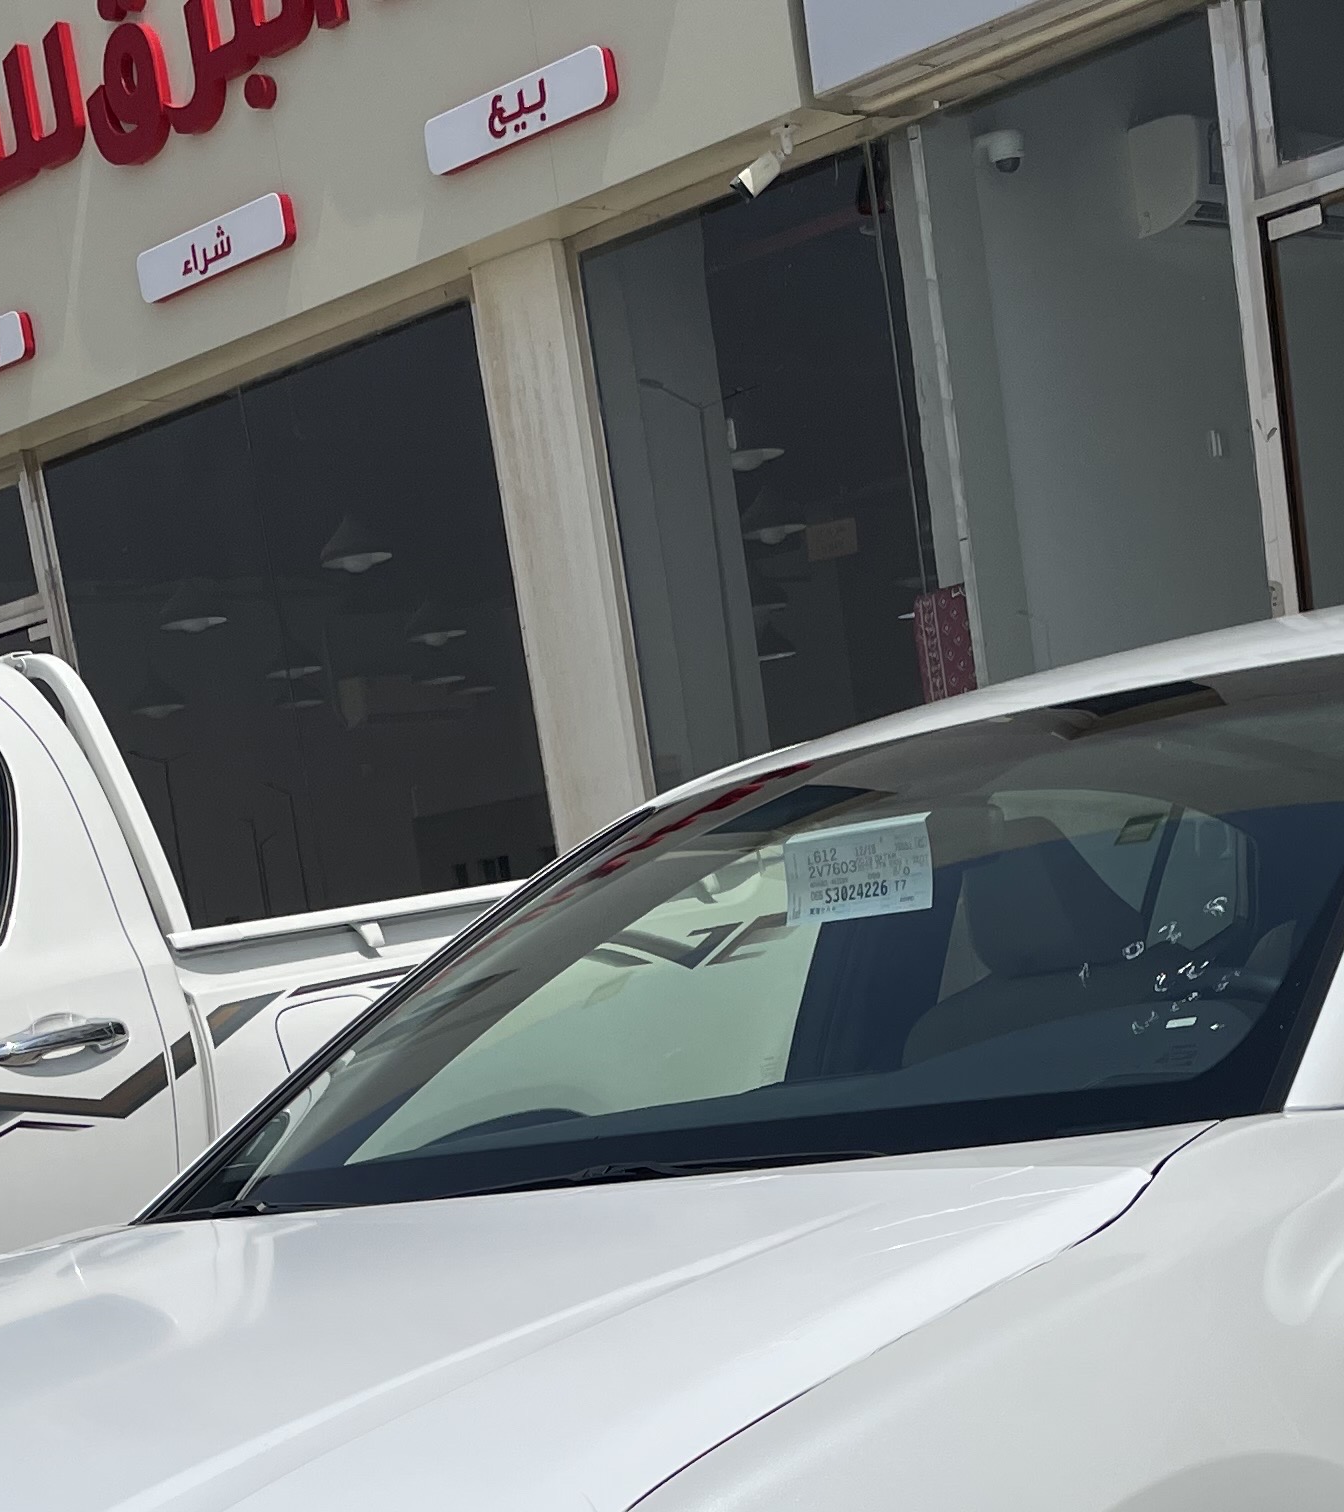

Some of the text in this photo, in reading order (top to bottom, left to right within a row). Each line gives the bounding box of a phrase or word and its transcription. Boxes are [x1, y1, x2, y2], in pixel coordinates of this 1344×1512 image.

[488, 77, 547, 139] بيع
[182, 225, 232, 276] شراء
[825, 879, 888, 904] S3024226
